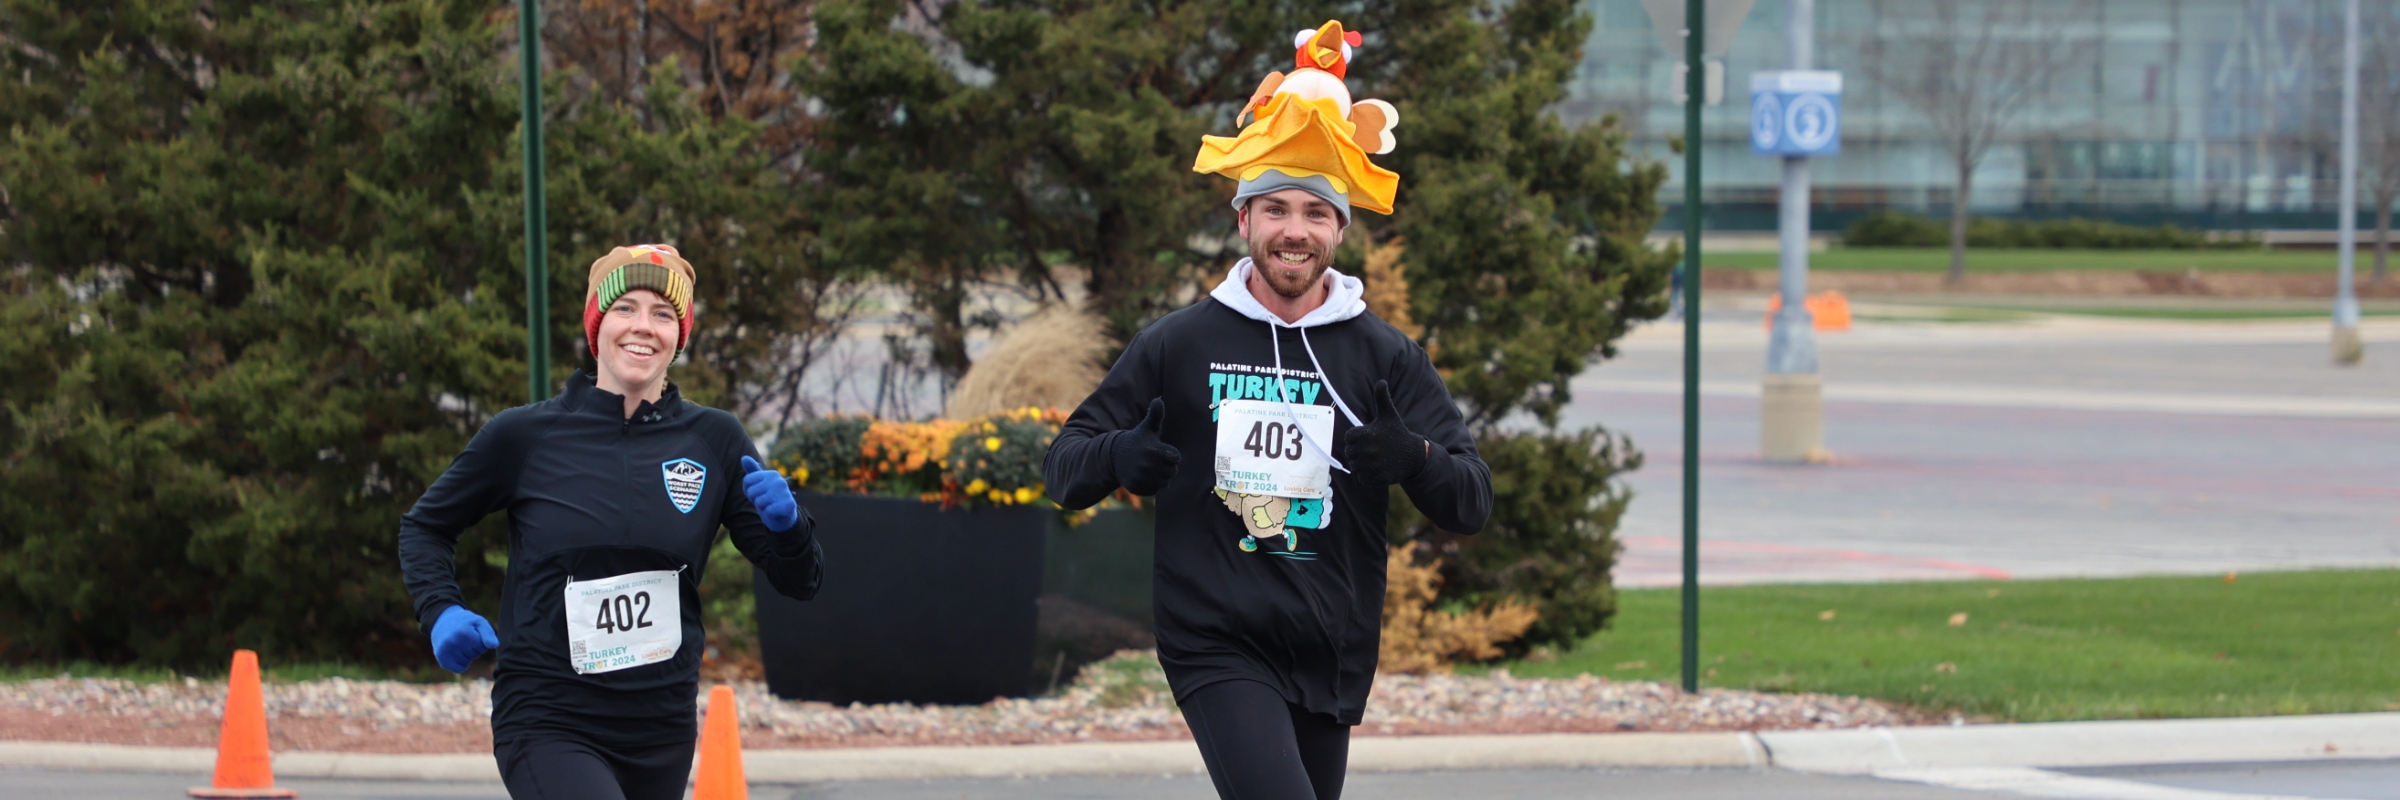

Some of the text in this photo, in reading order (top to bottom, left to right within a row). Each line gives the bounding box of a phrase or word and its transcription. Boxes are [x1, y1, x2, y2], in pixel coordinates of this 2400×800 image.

[1210, 362, 1320, 379] PALATINE PARK DISTRICT
[1287, 412, 1318, 420] STRICT
[1244, 420, 1303, 461] 403
[1232, 470, 1272, 481] TURKEY
[1225, 480, 1278, 492] TROT 2024
[581, 579, 662, 596] PALATINE PARK DISTRICT
[596, 591, 653, 634] 402
[589, 646, 627, 660] TURKEY
[583, 660, 608, 671] TROT
[612, 655, 636, 666] 2024
